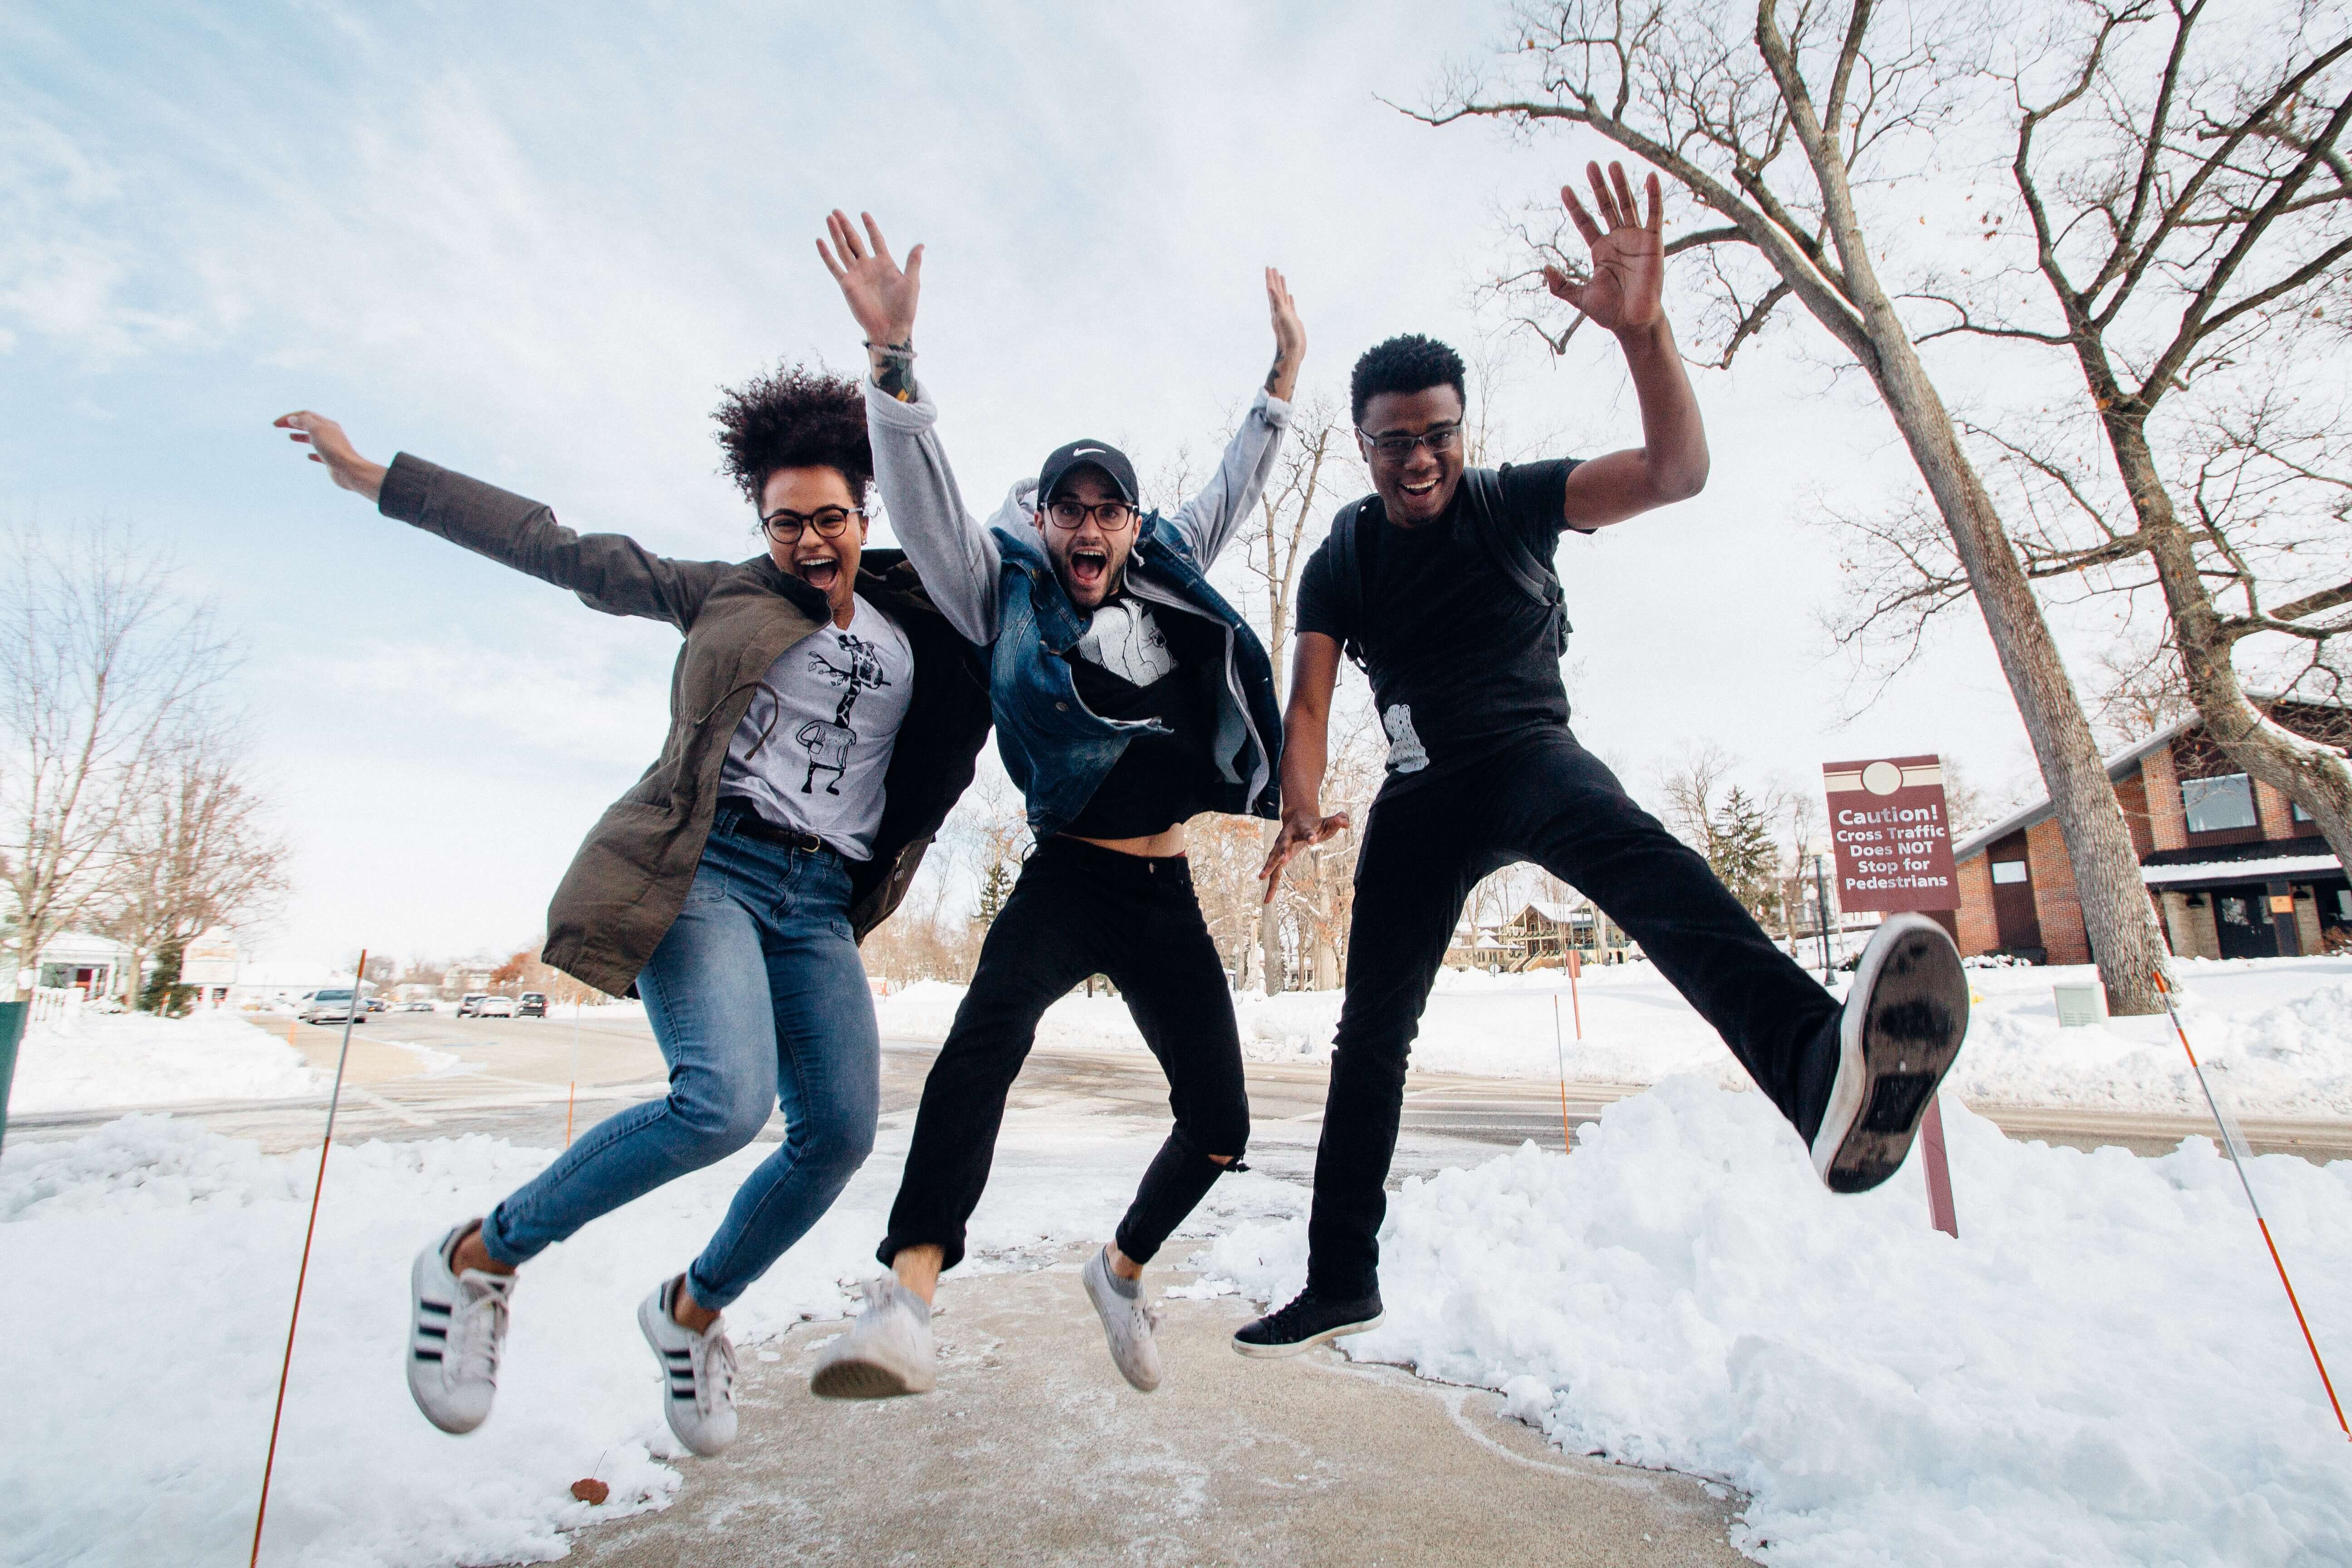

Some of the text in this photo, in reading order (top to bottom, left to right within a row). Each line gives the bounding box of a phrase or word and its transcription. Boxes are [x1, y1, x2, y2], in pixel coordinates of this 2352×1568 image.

[1838, 804, 1937, 825] Caution!
[1837, 825, 1945, 842] Cross Traffic
[1850, 841, 1933, 857] Does NOT
[1859, 858, 1930, 874] Stop for
[1846, 875, 1948, 890] Pedestrians
